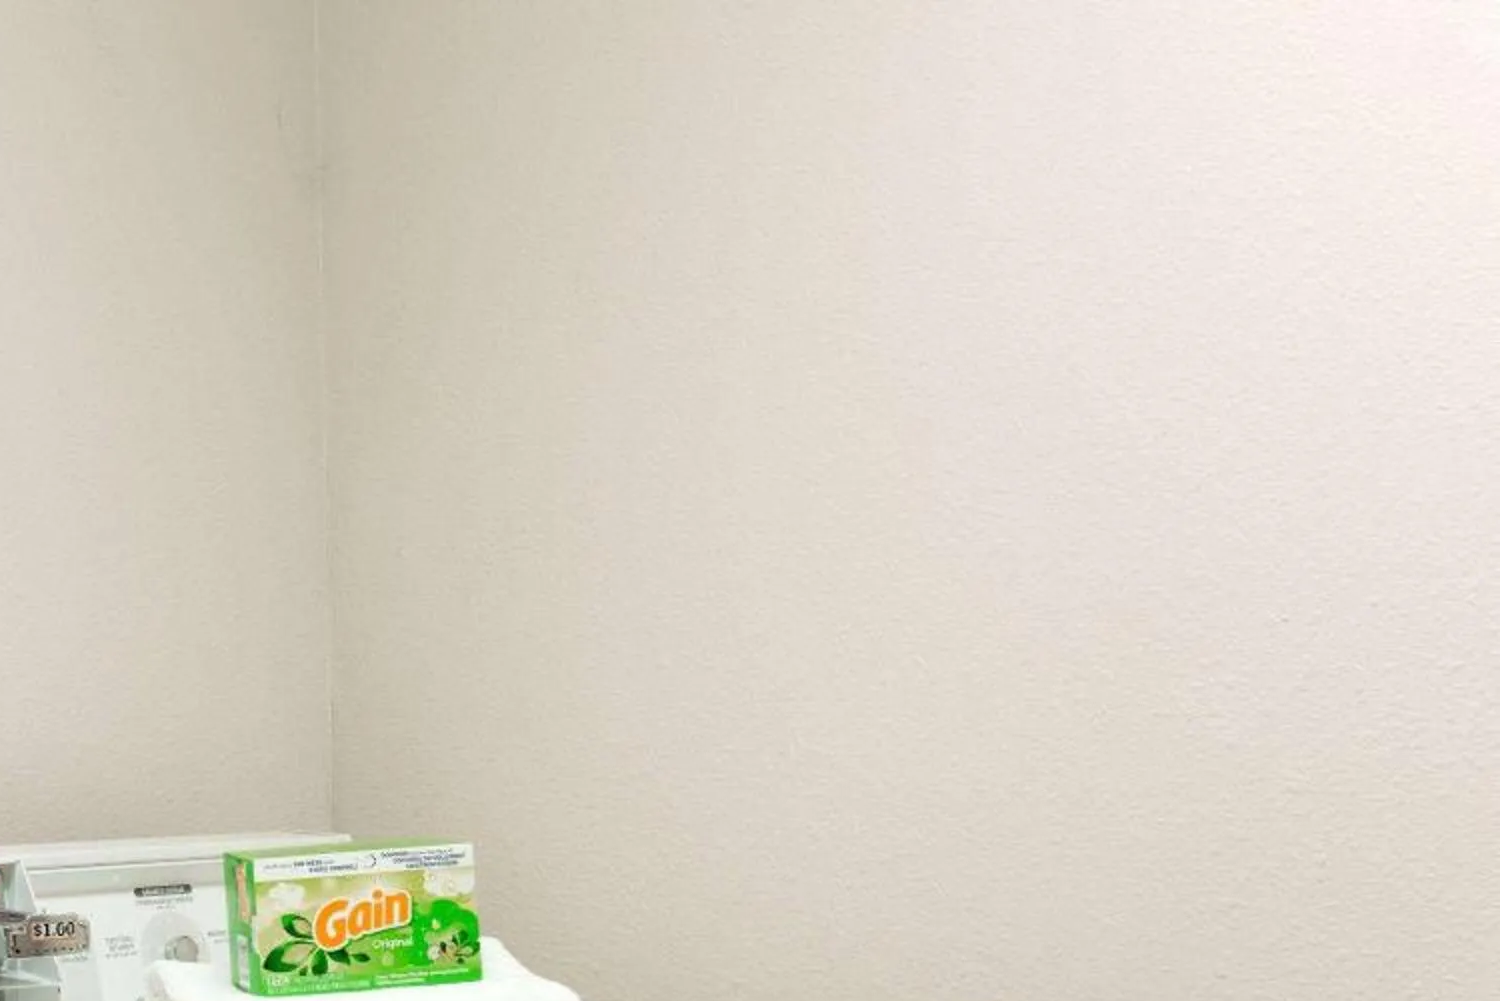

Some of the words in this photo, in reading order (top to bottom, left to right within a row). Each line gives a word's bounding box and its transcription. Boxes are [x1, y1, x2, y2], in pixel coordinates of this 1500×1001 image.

[314, 887, 411, 950] Gain
[33, 921, 76, 938] $1.00
[372, 938, 414, 951] Original
